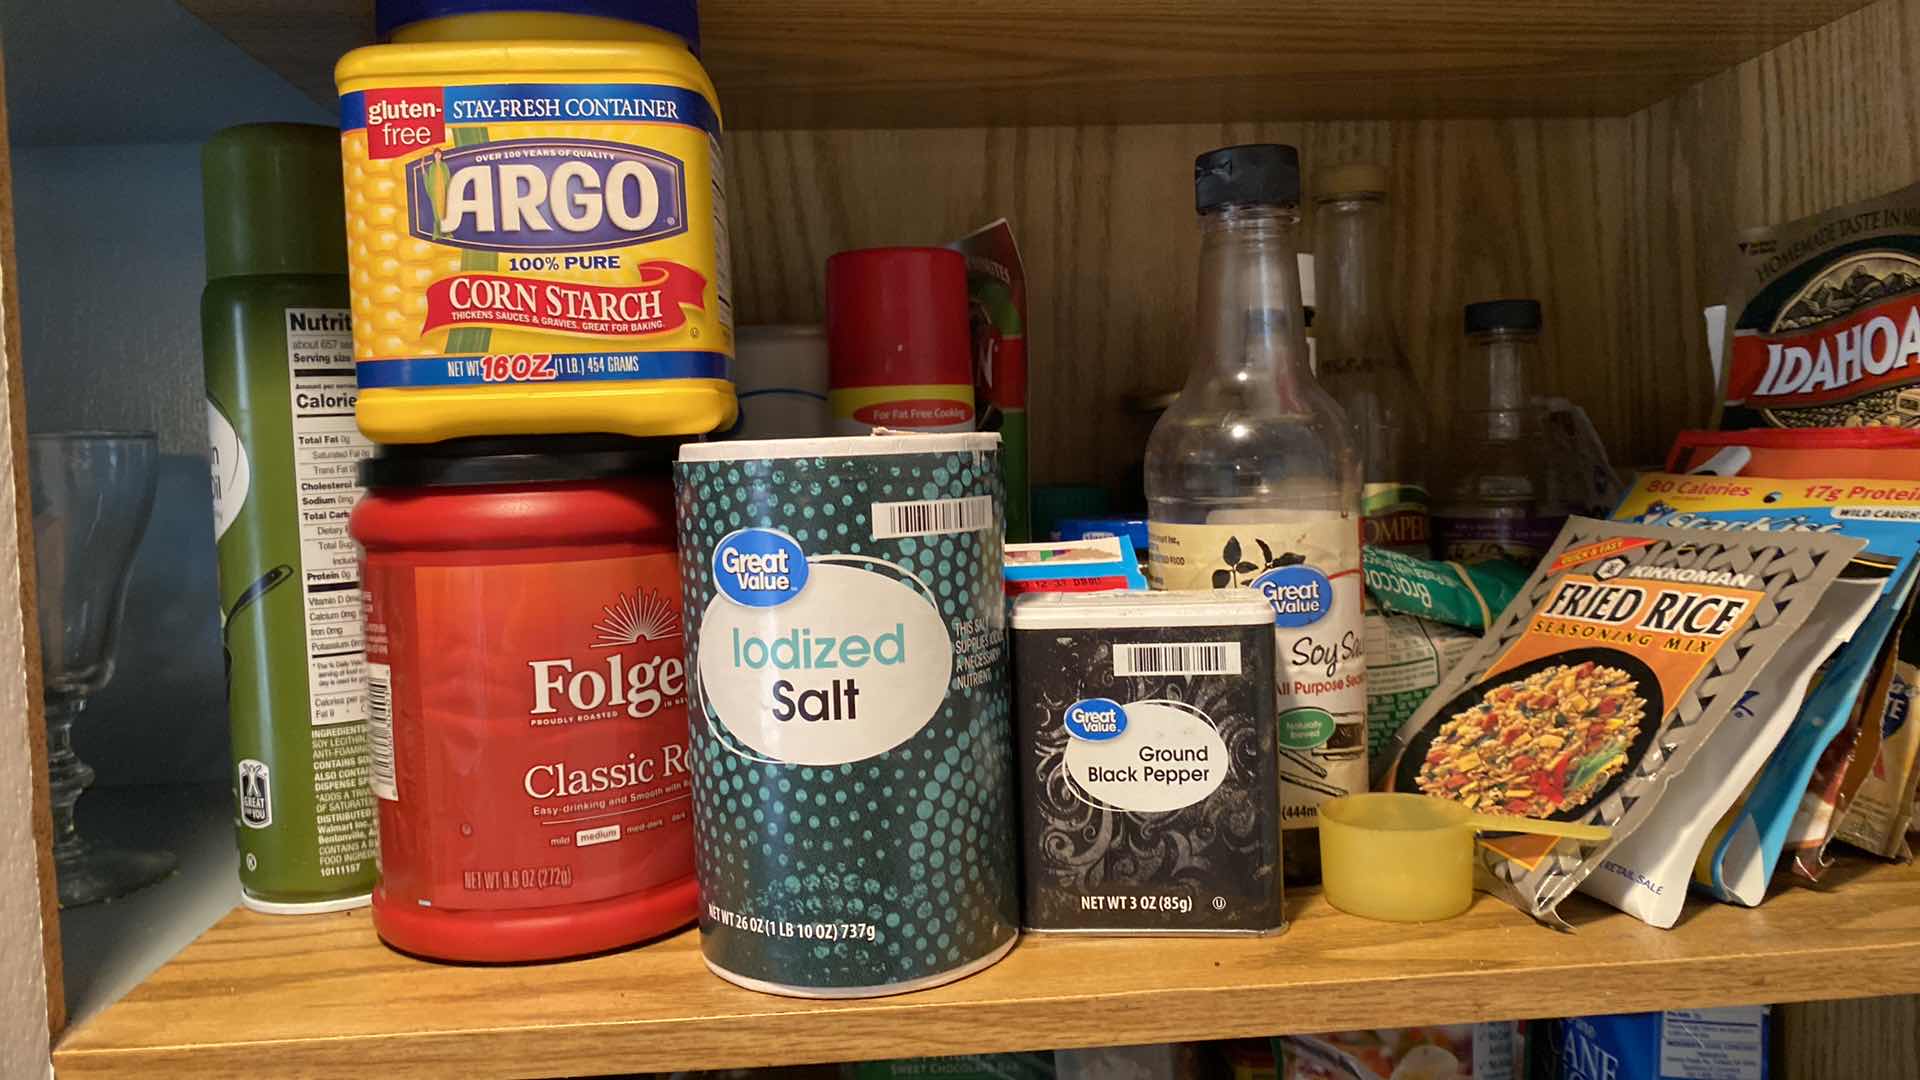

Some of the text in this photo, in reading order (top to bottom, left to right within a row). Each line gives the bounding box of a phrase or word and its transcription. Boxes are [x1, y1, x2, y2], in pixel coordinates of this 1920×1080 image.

[368, 100, 443, 125] gluten-
[453, 98, 679, 120] STAY-FRESH CONTAINER
[382, 123, 432, 145] free
[475, 149, 616, 163] OVER 100 YEARS OF QUALITY
[442, 161, 659, 232] ARGO
[1839, 210, 1881, 236] TASTE
[1883, 209, 1900, 224] IN
[509, 255, 621, 272] 100% PURE
[448, 278, 662, 322] CORN STARCH
[451, 311, 494, 321] THICKENS
[495, 312, 530, 323] SAUCES
[532, 315, 540, 324] &
[582, 321, 610, 332] GREAT
[611, 323, 629, 333] FOR
[294, 352, 331, 364] Serving
[1753, 305, 1920, 396] IDAHOA
[448, 361, 464, 378] NET
[587, 359, 605, 376] 454
[607, 358, 640, 376] GRAMS
[298, 435, 339, 445] Total Fat
[301, 479, 352, 491] Cholesterol
[1646, 480, 1671, 493] 80
[1677, 481, 1752, 497] Calories
[1804, 485, 1842, 501] 17g
[302, 495, 337, 506] Sodium
[303, 511, 327, 522] Total
[1839, 508, 1872, 519] WILD
[317, 524, 343, 536] Dietary
[318, 541, 337, 552] Total
[722, 546, 789, 574] Great
[307, 570, 340, 582] Protein
[737, 573, 790, 591] Value
[1628, 565, 1755, 588] KIKKOMAN
[1261, 581, 1320, 602] Great
[308, 596, 336, 607] Vitamin
[1273, 600, 1321, 613] Value
[1544, 582, 1745, 635] FRIED RICE
[309, 611, 339, 622] Calcium
[310, 626, 343, 636] Iron 0mg
[1533, 619, 1714, 653] SEASONING MIX
[732, 623, 905, 669] Iodized
[1291, 636, 1338, 678] Soy
[528, 653, 686, 718] Folge
[1294, 679, 1344, 697] Purpose
[772, 679, 859, 721] Salt
[530, 716, 574, 726] PROUDLY
[1072, 708, 1117, 724] Great
[1082, 722, 1118, 733] Value
[1139, 745, 1209, 762] Ground
[314, 770, 337, 782] ALSO
[524, 752, 655, 798] Classic
[1088, 766, 1210, 786] Black Pepper
[533, 798, 605, 816] Easy-drinking
[608, 796, 628, 805] and
[630, 787, 663, 802] Smooth
[1282, 804, 1320, 821] (444m
[317, 822, 353, 834] Walmart
[550, 835, 570, 847] mild
[580, 827, 617, 843] medium
[320, 854, 342, 866] FOOD
[464, 871, 481, 889] NET
[482, 871, 499, 889] WT
[519, 869, 533, 888] OZ
[1636, 874, 1664, 896] SALE
[1081, 895, 1193, 912] NET WT 3 OZ (85g)
[709, 903, 876, 942] NET WT 26 OZ (1 LB 10 OZ) 737g
